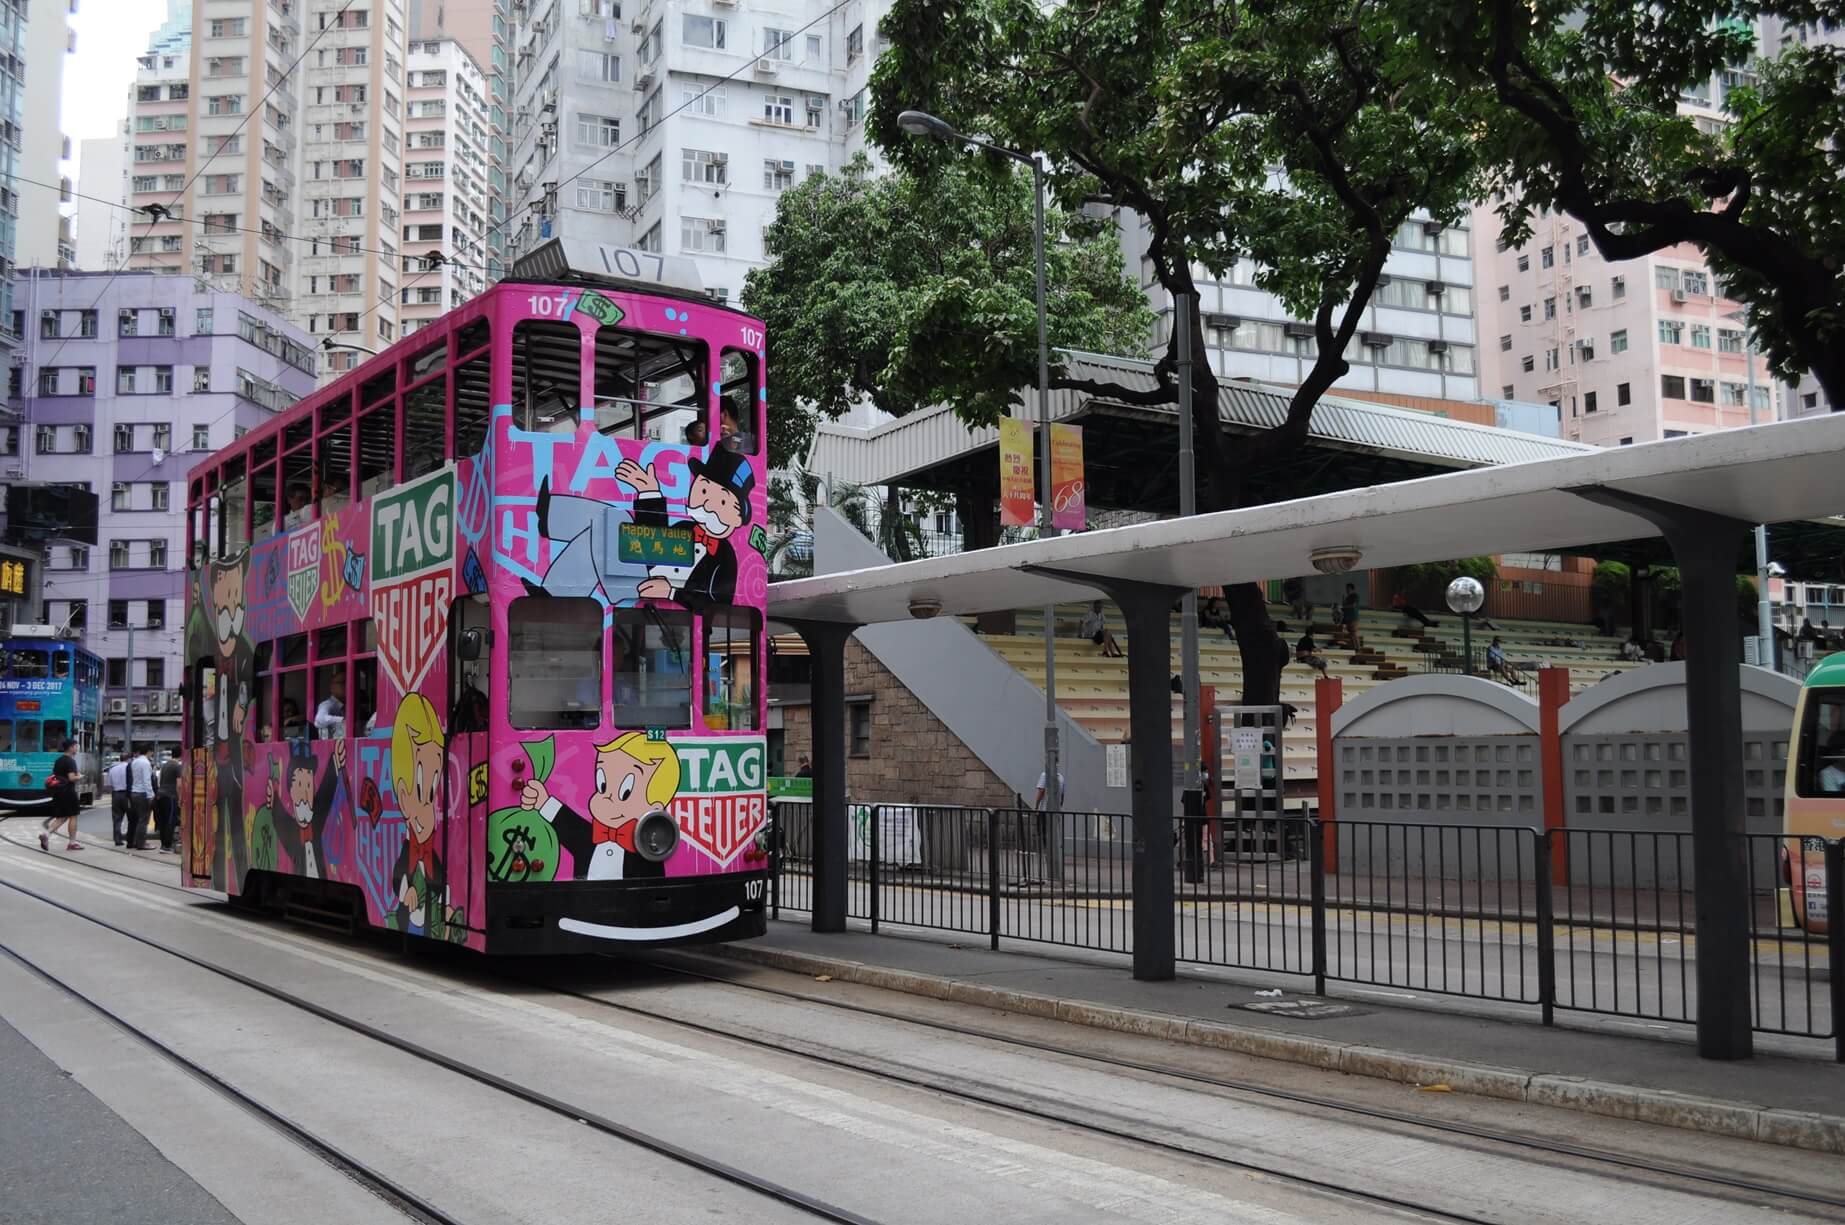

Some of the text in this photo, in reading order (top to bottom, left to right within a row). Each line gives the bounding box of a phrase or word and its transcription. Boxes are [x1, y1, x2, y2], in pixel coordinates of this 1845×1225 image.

[600, 247, 664, 282] 107
[528, 295, 567, 316] 107
[741, 327, 763, 349] 107
[508, 428, 692, 500] TAG
[377, 484, 449, 573] TAG
[622, 523, 693, 543] Happy Valley
[291, 535, 317, 570] TAG
[289, 568, 318, 611] HEUER
[374, 578, 449, 679] HEUER
[32, 681, 45, 690] DEC
[46, 682, 63, 691] 2017
[647, 729, 664, 740] S12
[361, 746, 397, 806] TA
[677, 748, 761, 790] TAG
[676, 798, 762, 858] HEUER
[745, 881, 763, 900] 107
